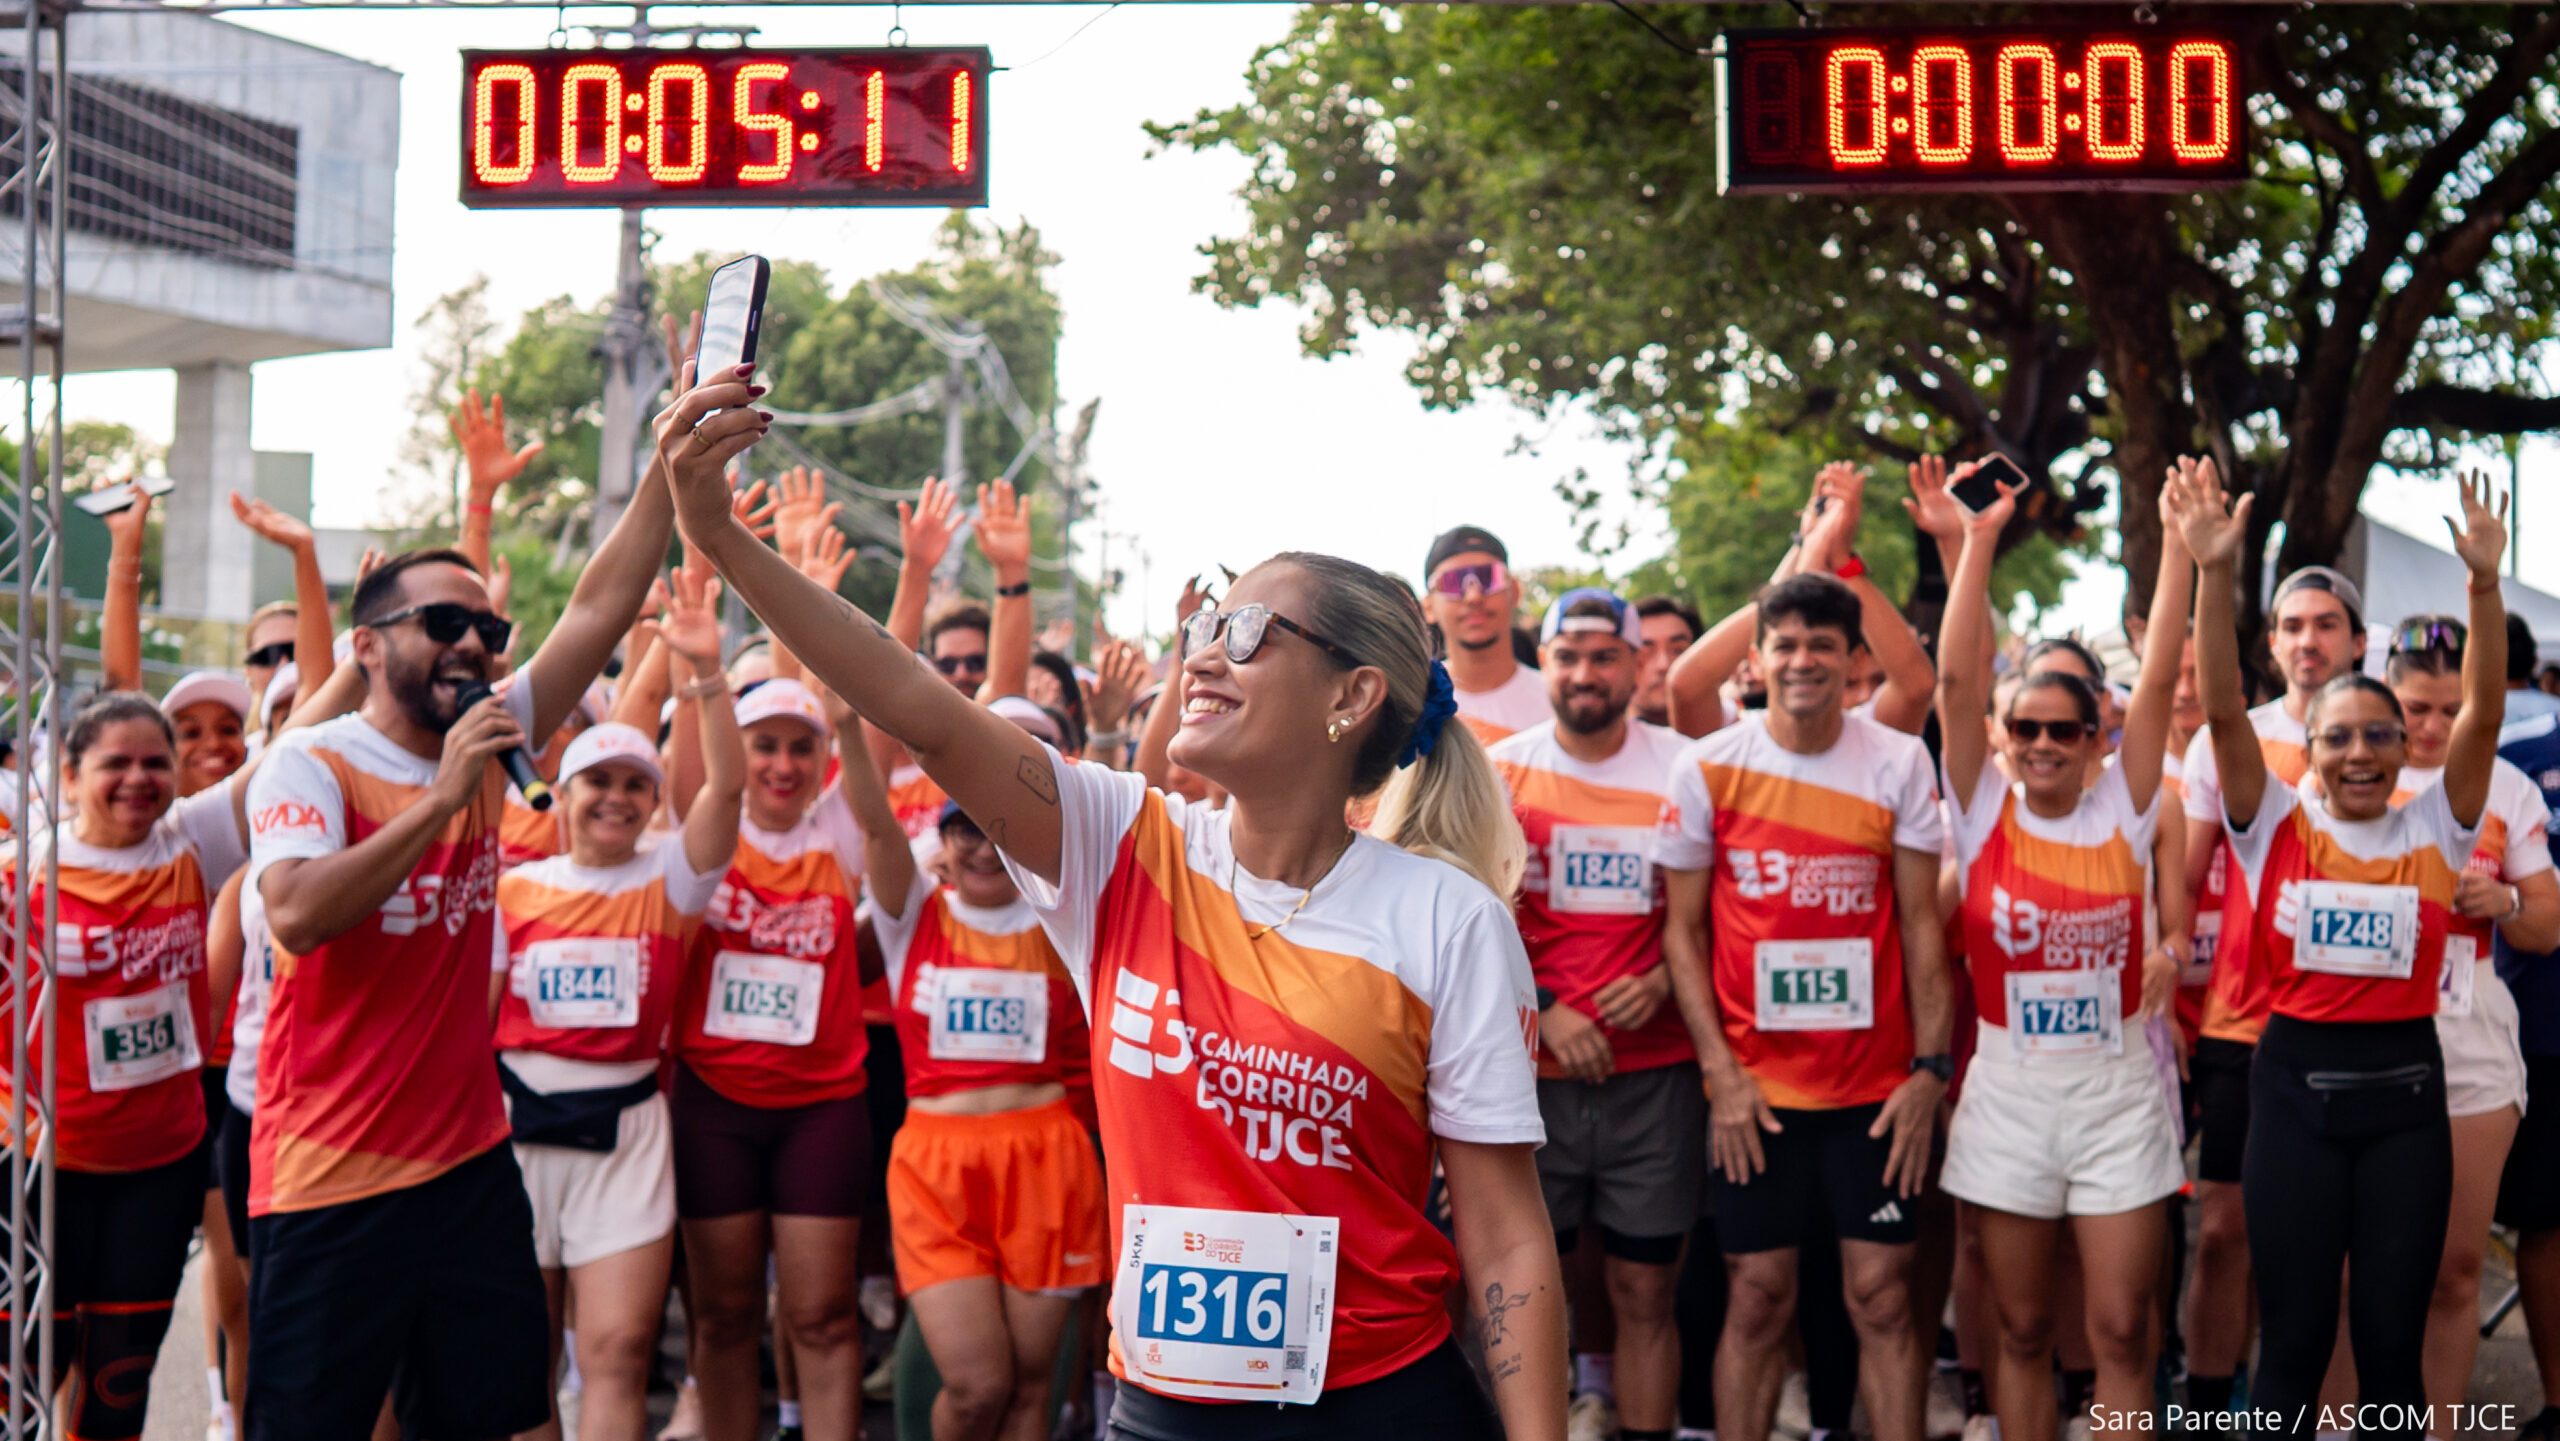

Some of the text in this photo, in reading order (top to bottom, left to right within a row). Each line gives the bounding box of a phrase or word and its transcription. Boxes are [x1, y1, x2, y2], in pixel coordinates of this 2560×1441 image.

[1568, 855, 1641, 886] 1849
[2315, 911, 2391, 947] 1248
[541, 967, 615, 999] 1844
[727, 981, 797, 1019] 1055
[1782, 970, 1839, 1001] 115
[950, 999, 1023, 1032] 1168
[2024, 1000, 2099, 1034] 1784
[115, 1015, 168, 1061] 356
[1200, 1031, 1368, 1101] CAMINHADA
[1238, 1105, 1353, 1172] TJCE
[1129, 1233, 1145, 1268] 5KM
[1218, 1251, 1242, 1263] TJCE
[1145, 1269, 1283, 1342] 1316
